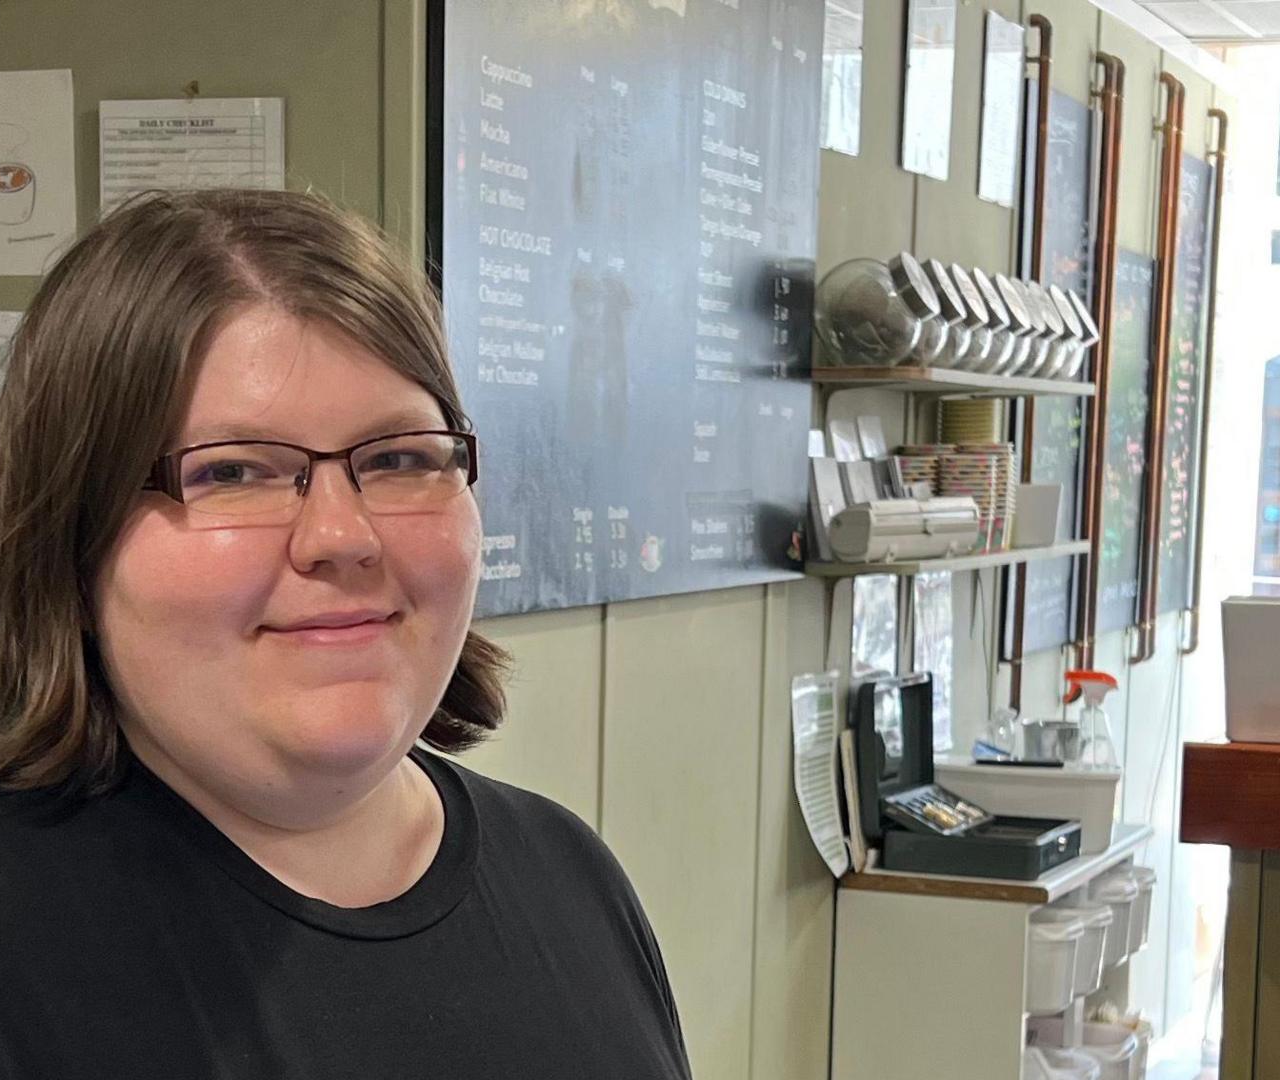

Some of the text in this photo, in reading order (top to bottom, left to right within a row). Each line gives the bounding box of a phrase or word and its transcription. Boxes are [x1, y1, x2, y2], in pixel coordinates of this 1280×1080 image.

[139, 119, 165, 128] DAILY
[480, 152, 528, 180] Americano
[480, 224, 552, 256] HOT CHOCOLATE
